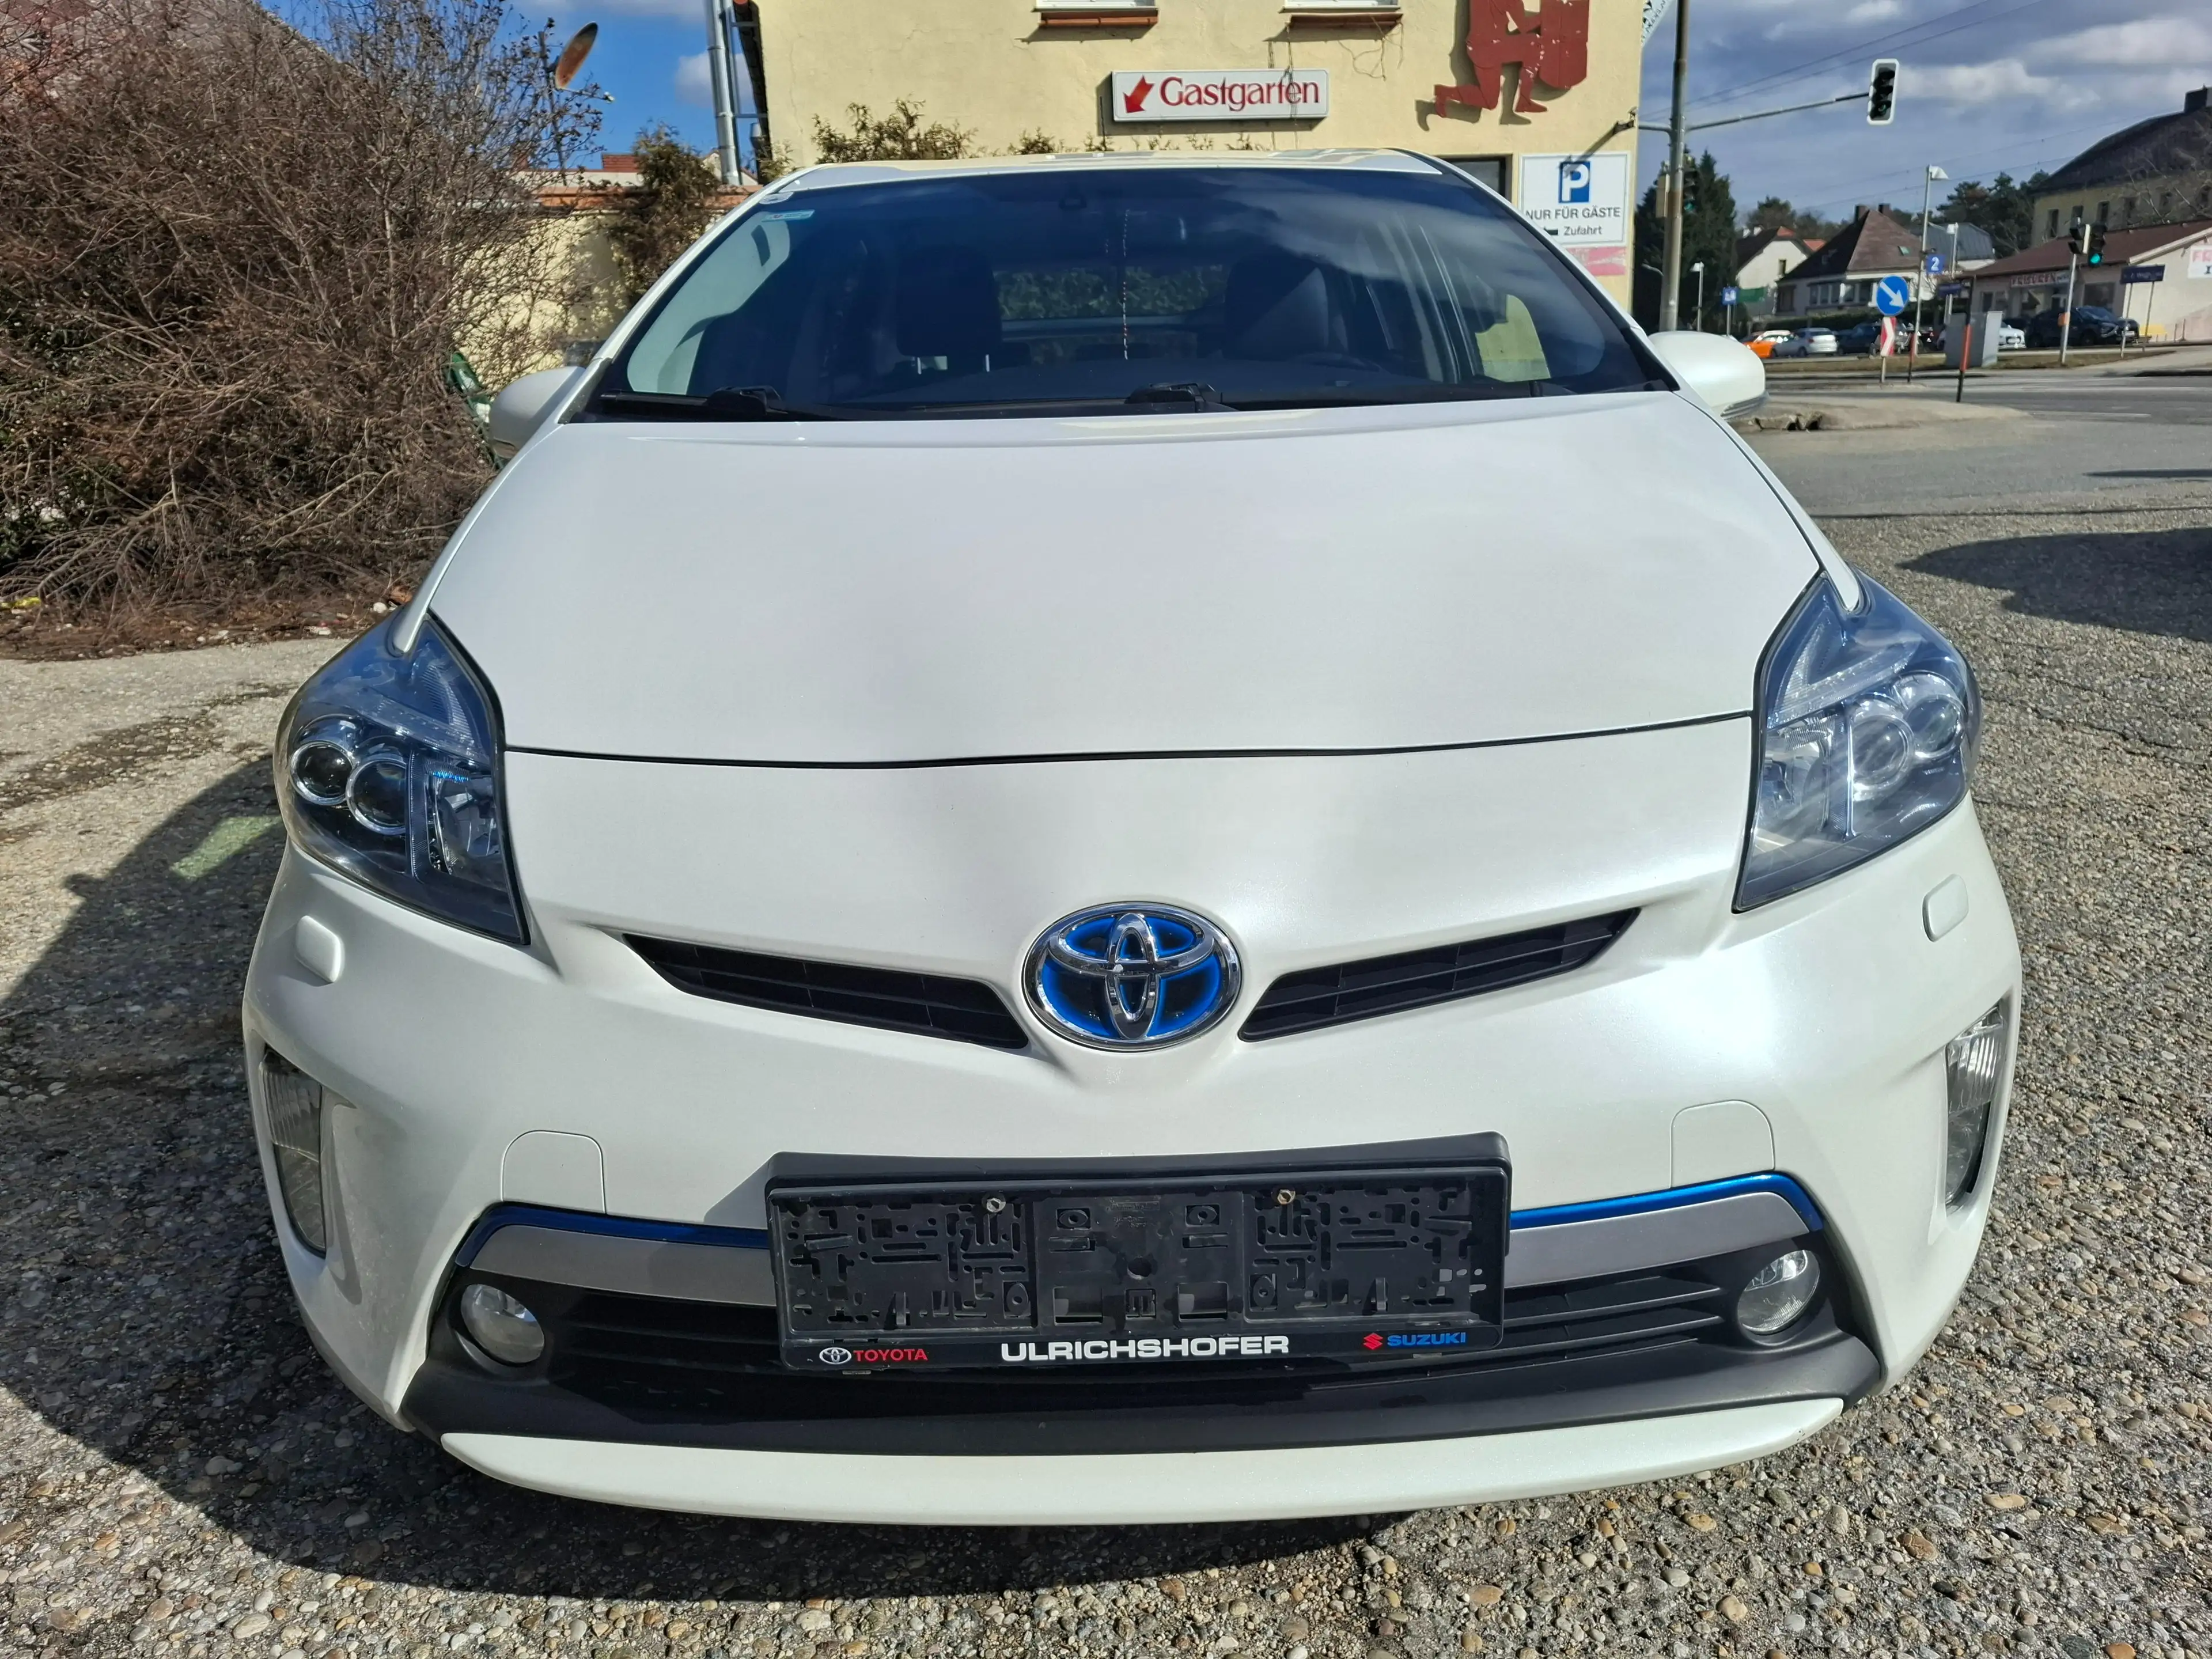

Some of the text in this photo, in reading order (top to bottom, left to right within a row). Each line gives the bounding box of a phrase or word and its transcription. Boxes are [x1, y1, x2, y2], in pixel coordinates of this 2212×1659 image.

[1160, 76, 1320, 112] Gastgarten
[1562, 164, 1589, 202] P
[1526, 205, 1621, 219] NUR FÜR GÄSTE
[1563, 226, 1603, 236] Zufahrt
[1930, 256, 1940, 271] 2
[1387, 1331, 1467, 1347] SUZUKI
[853, 1349, 929, 1362] TOYOTA
[1001, 1335, 1290, 1362] ULRICHSHOFER
